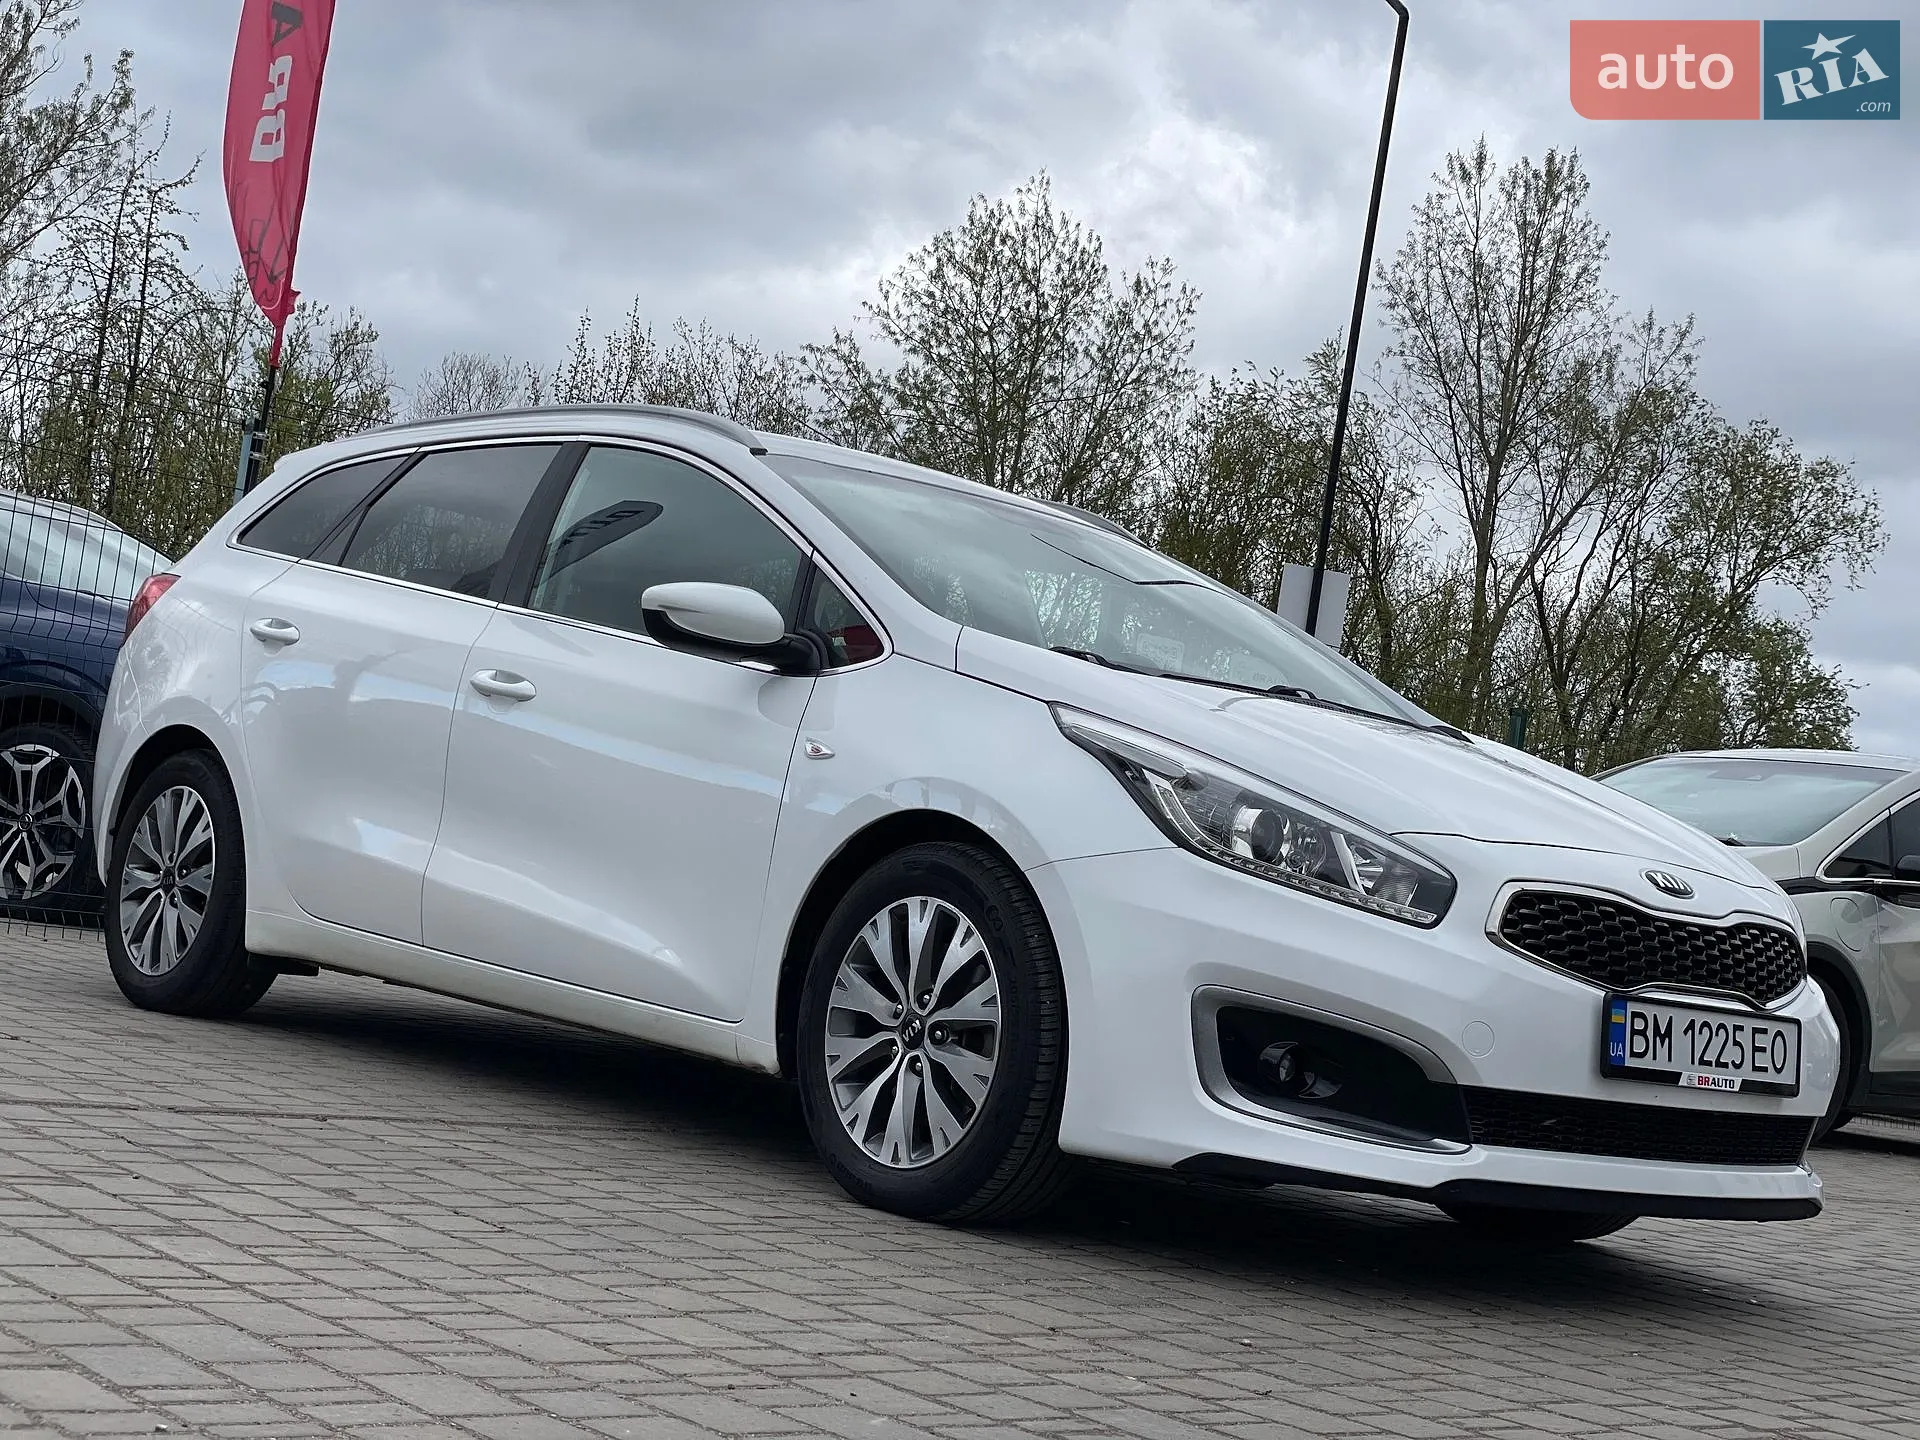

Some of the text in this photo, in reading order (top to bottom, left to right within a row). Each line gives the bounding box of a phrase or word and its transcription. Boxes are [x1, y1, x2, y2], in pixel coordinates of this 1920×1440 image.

[1648, 872, 1692, 892] KIA
[902, 1019, 921, 1042] KIA
[1609, 1041, 1624, 1058] UA
[1629, 1010, 1788, 1075] BM 1225 EO
[1697, 1075, 1735, 1089] BRAUTO
